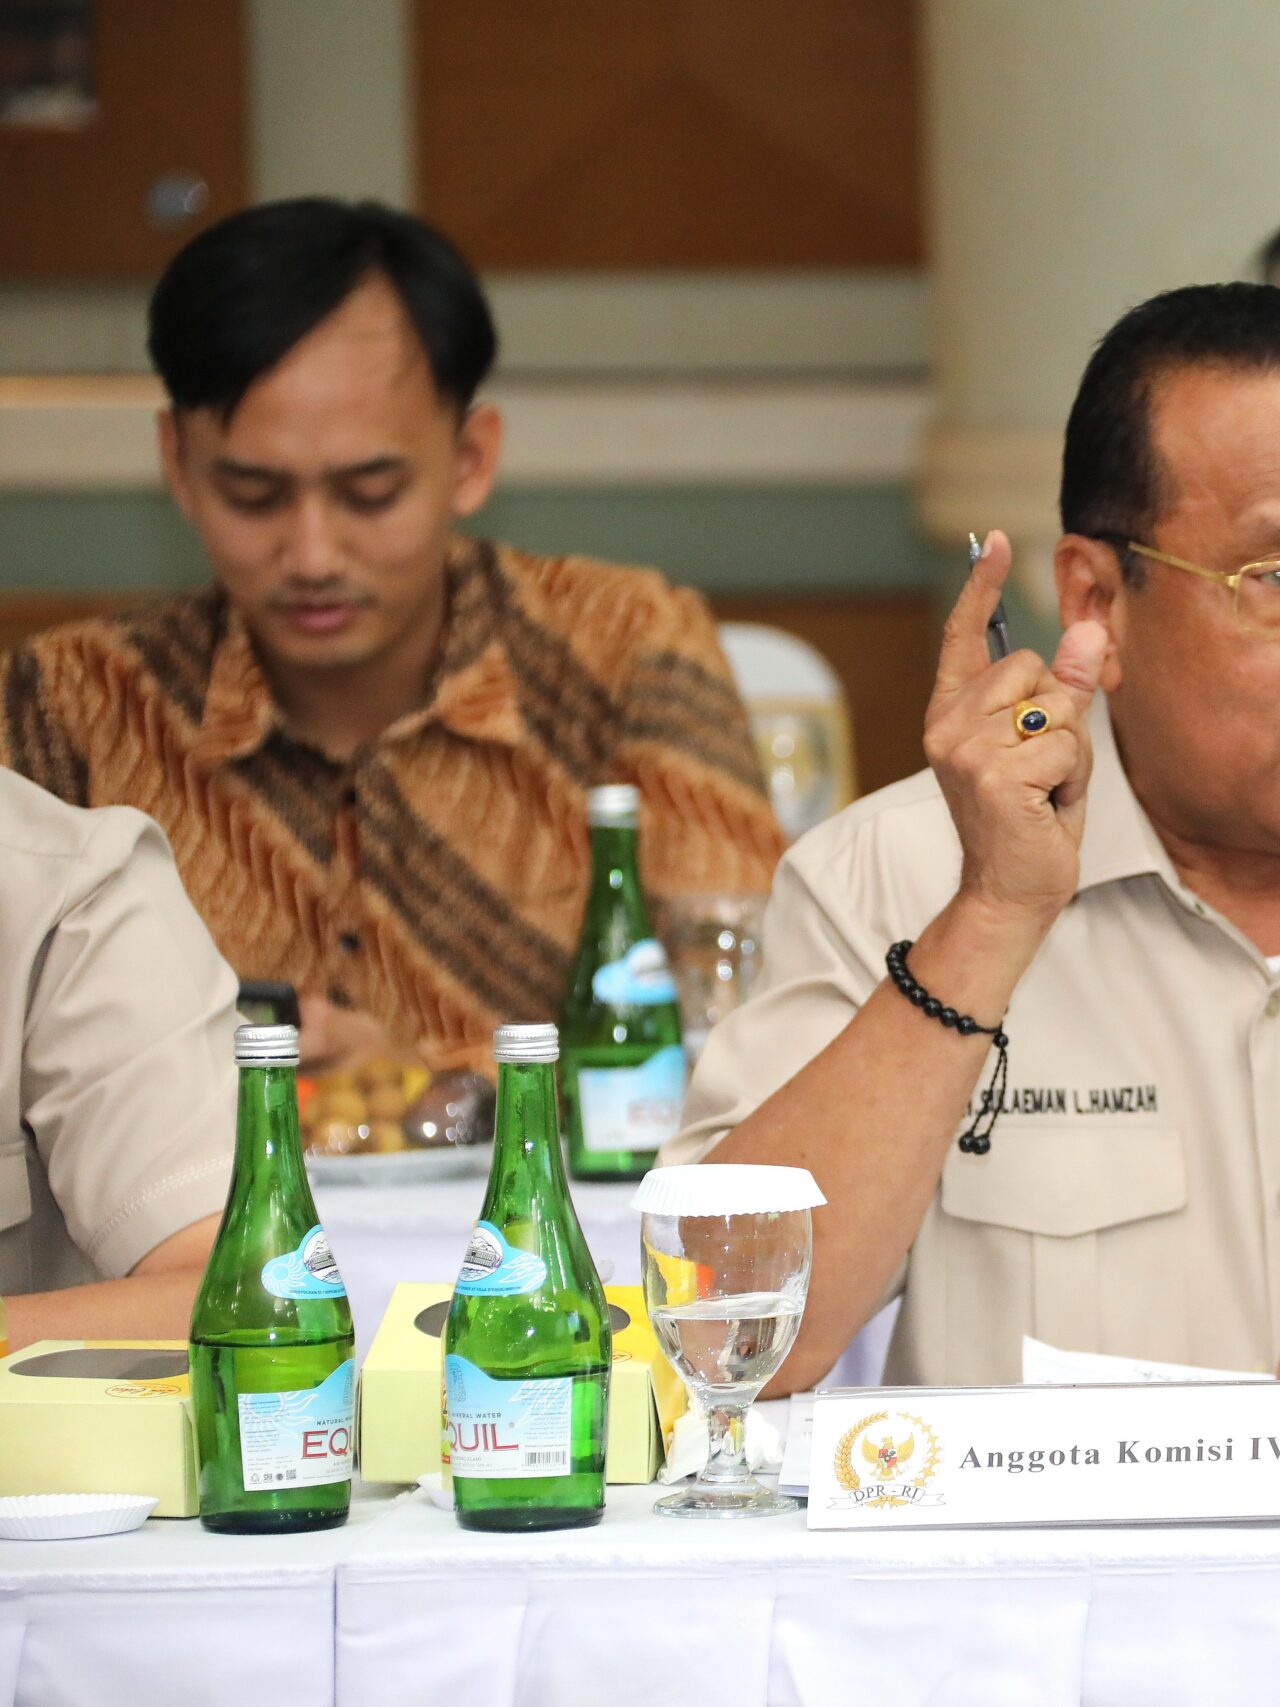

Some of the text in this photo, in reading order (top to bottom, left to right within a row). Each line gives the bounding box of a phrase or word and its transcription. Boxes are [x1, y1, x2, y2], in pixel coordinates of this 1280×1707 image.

[1073, 1085, 1158, 1114] L.HAMZAH
[316, 1418, 344, 1426] NATURAL
[958, 1445, 1101, 1473] Anggota
[1117, 1437, 1234, 1464] Komisi
[853, 1485, 887, 1502] DPR
[901, 1485, 920, 1500] RI
